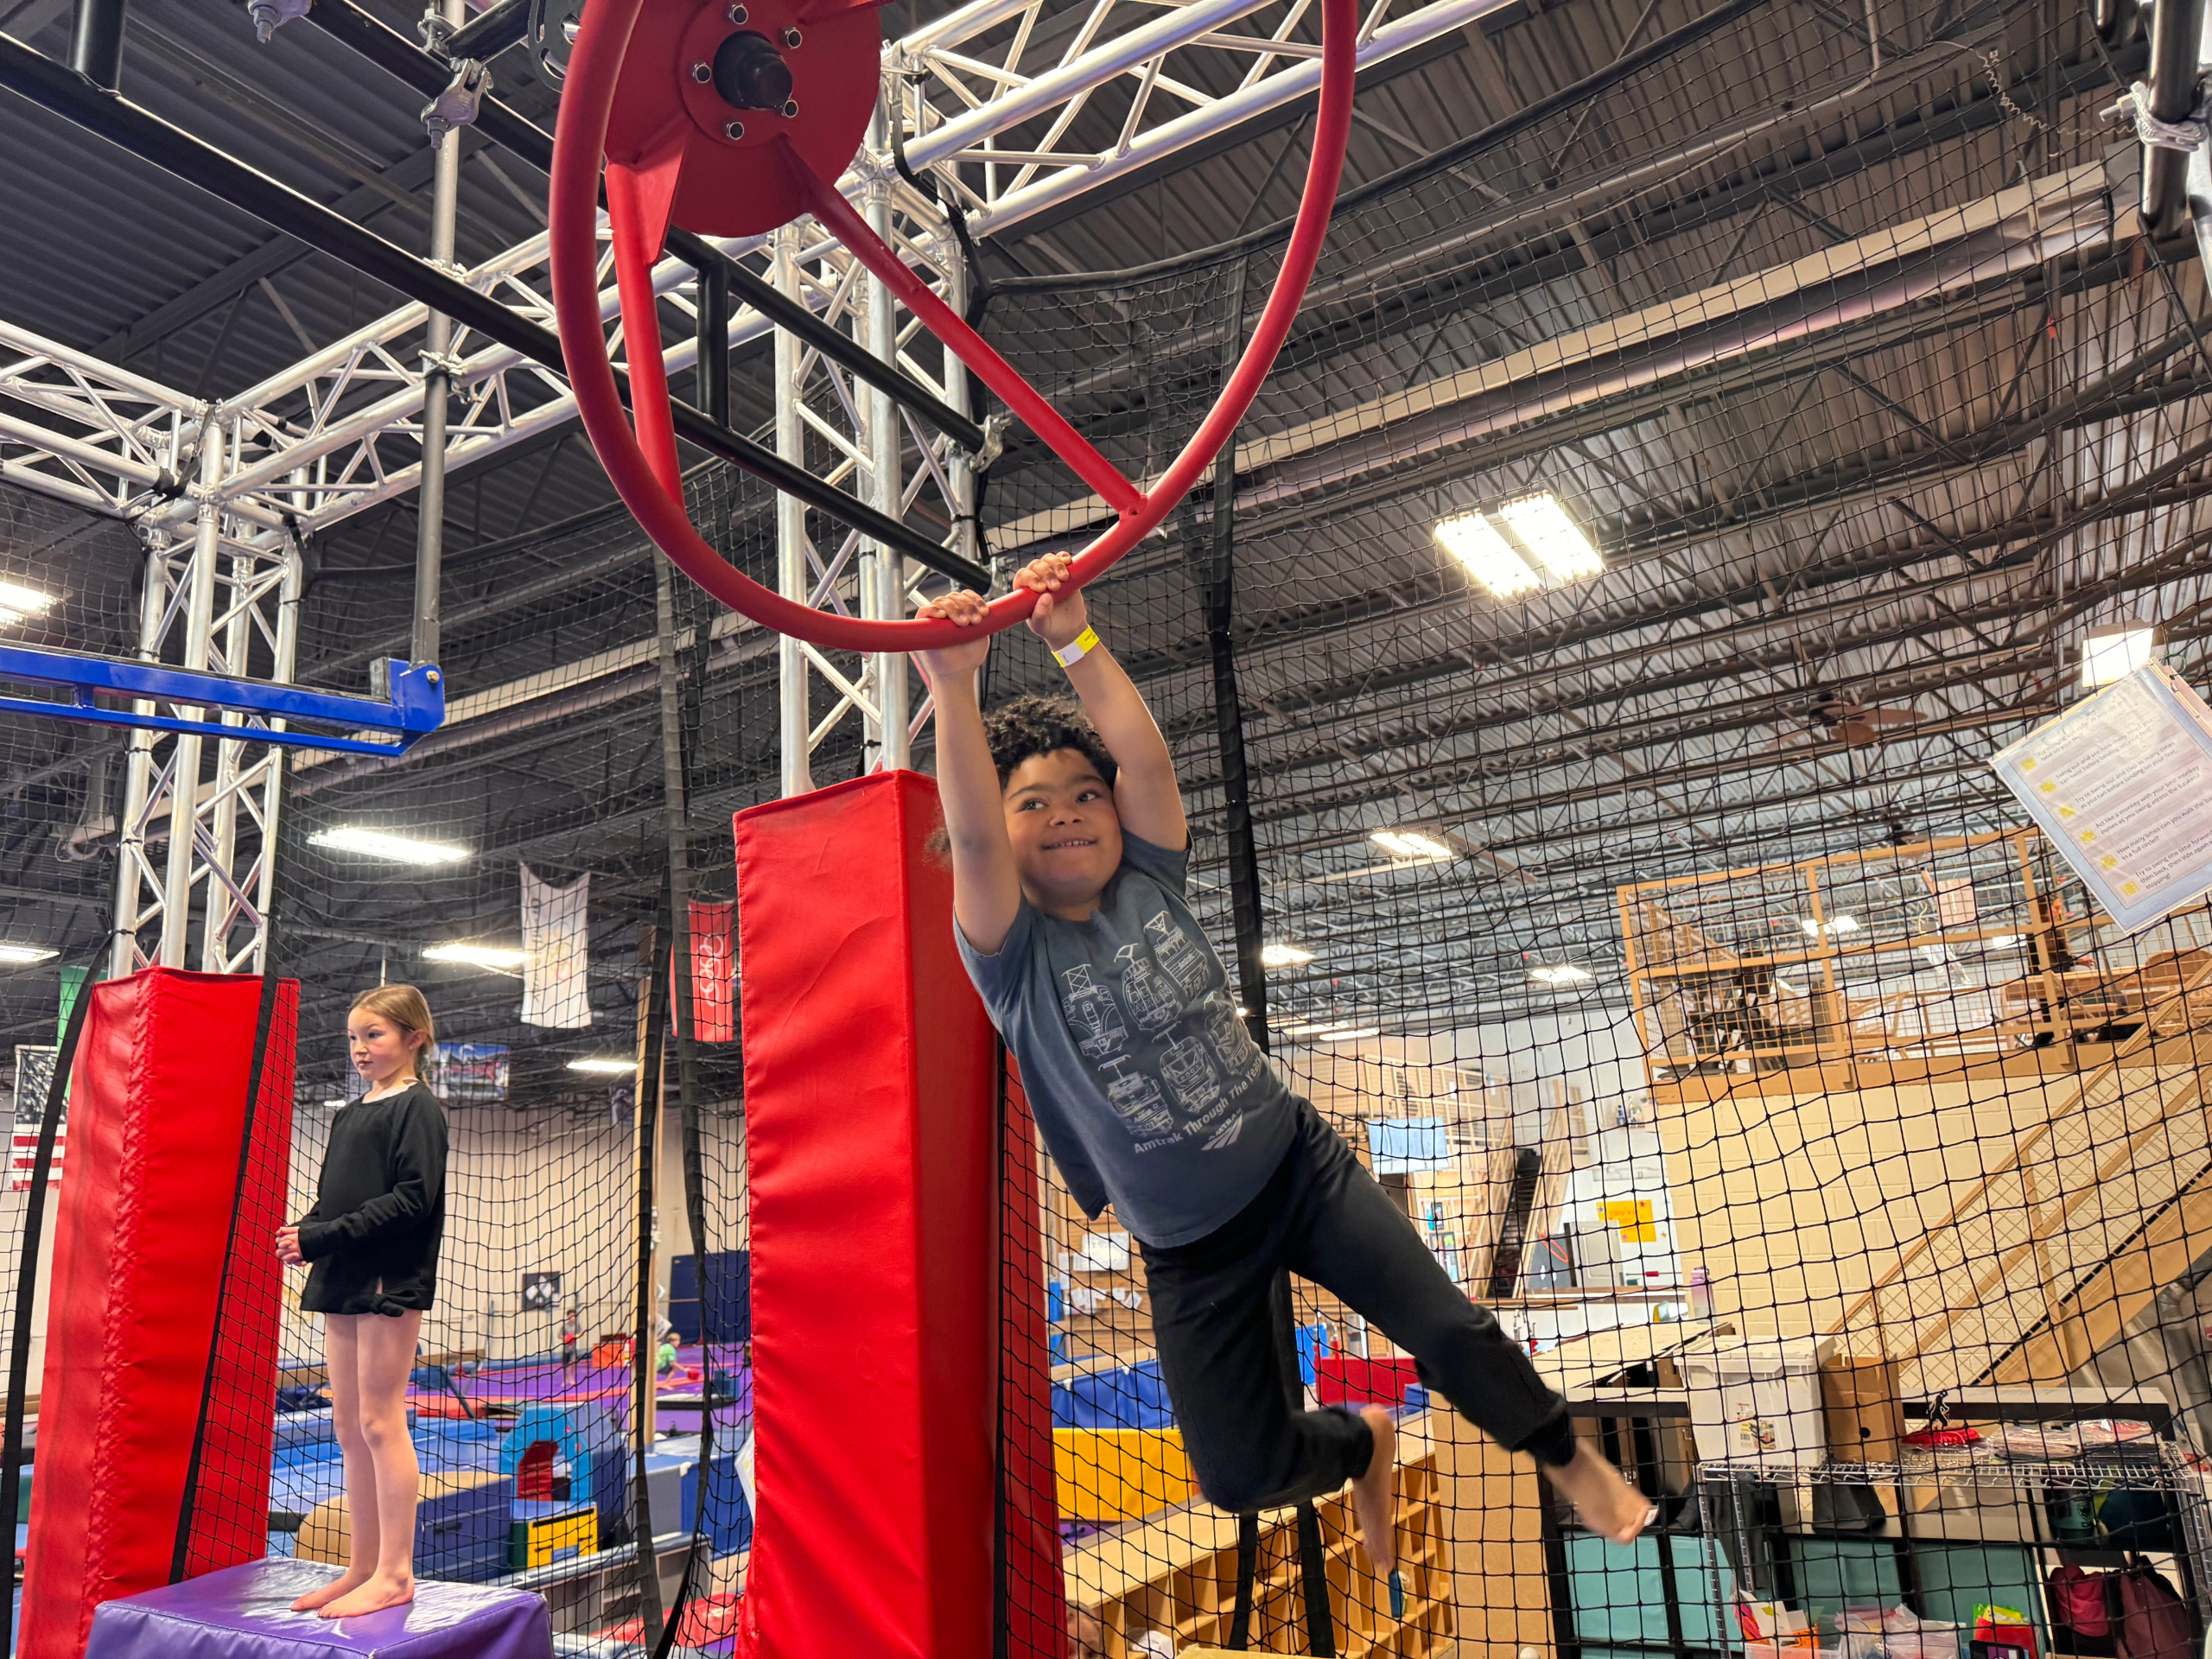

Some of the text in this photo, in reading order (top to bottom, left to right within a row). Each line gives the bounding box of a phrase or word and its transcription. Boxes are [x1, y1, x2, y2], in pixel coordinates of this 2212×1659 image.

[2055, 767, 2072, 779] Swing
[2081, 755, 2091, 764] and
[2100, 743, 2113, 752] how
[2112, 734, 2127, 745] many
[2141, 718, 2153, 728] you
[2059, 741, 2072, 750] your
[2069, 769, 2083, 779] twist
[2082, 759, 2101, 771] before
[2099, 747, 2120, 760] landing
[2126, 734, 2139, 745] your
[2090, 783, 2107, 794] swing
[2115, 770, 2126, 779] and
[2126, 764, 2138, 772] clap
[2144, 750, 2160, 761] many
[2159, 742, 2175, 753] times
[2087, 797, 2098, 806] you
[2106, 780, 2125, 793] before
[2123, 768, 2145, 782] landing
[2152, 756, 2164, 766] your
[2101, 823, 2119, 835] noises
[2124, 812, 2136, 821] you
[2135, 803, 2152, 814] swing
[2152, 792, 2169, 805] across
[2177, 772, 2201, 789] baskets!
[2119, 800, 2140, 815] monkey
[2139, 793, 2152, 802] with
[2152, 785, 2164, 797] your
[2164, 778, 2177, 787] best
[2177, 766, 2199, 780] monkey
[2116, 845, 2130, 855] How
[2129, 836, 2145, 847] many
[2144, 827, 2161, 838] times
[2160, 821, 2171, 830] can
[2170, 815, 2182, 824] you
[2181, 807, 2195, 817] walk
[2178, 843, 2191, 853] time
[2140, 874, 2154, 883] then
[2168, 858, 2182, 868] then
[2181, 852, 2194, 861] side
[2194, 842, 2209, 854] again
[2145, 873, 2171, 889] stopping!
[1135, 1055, 1263, 1154] Amtrak Through The Year
